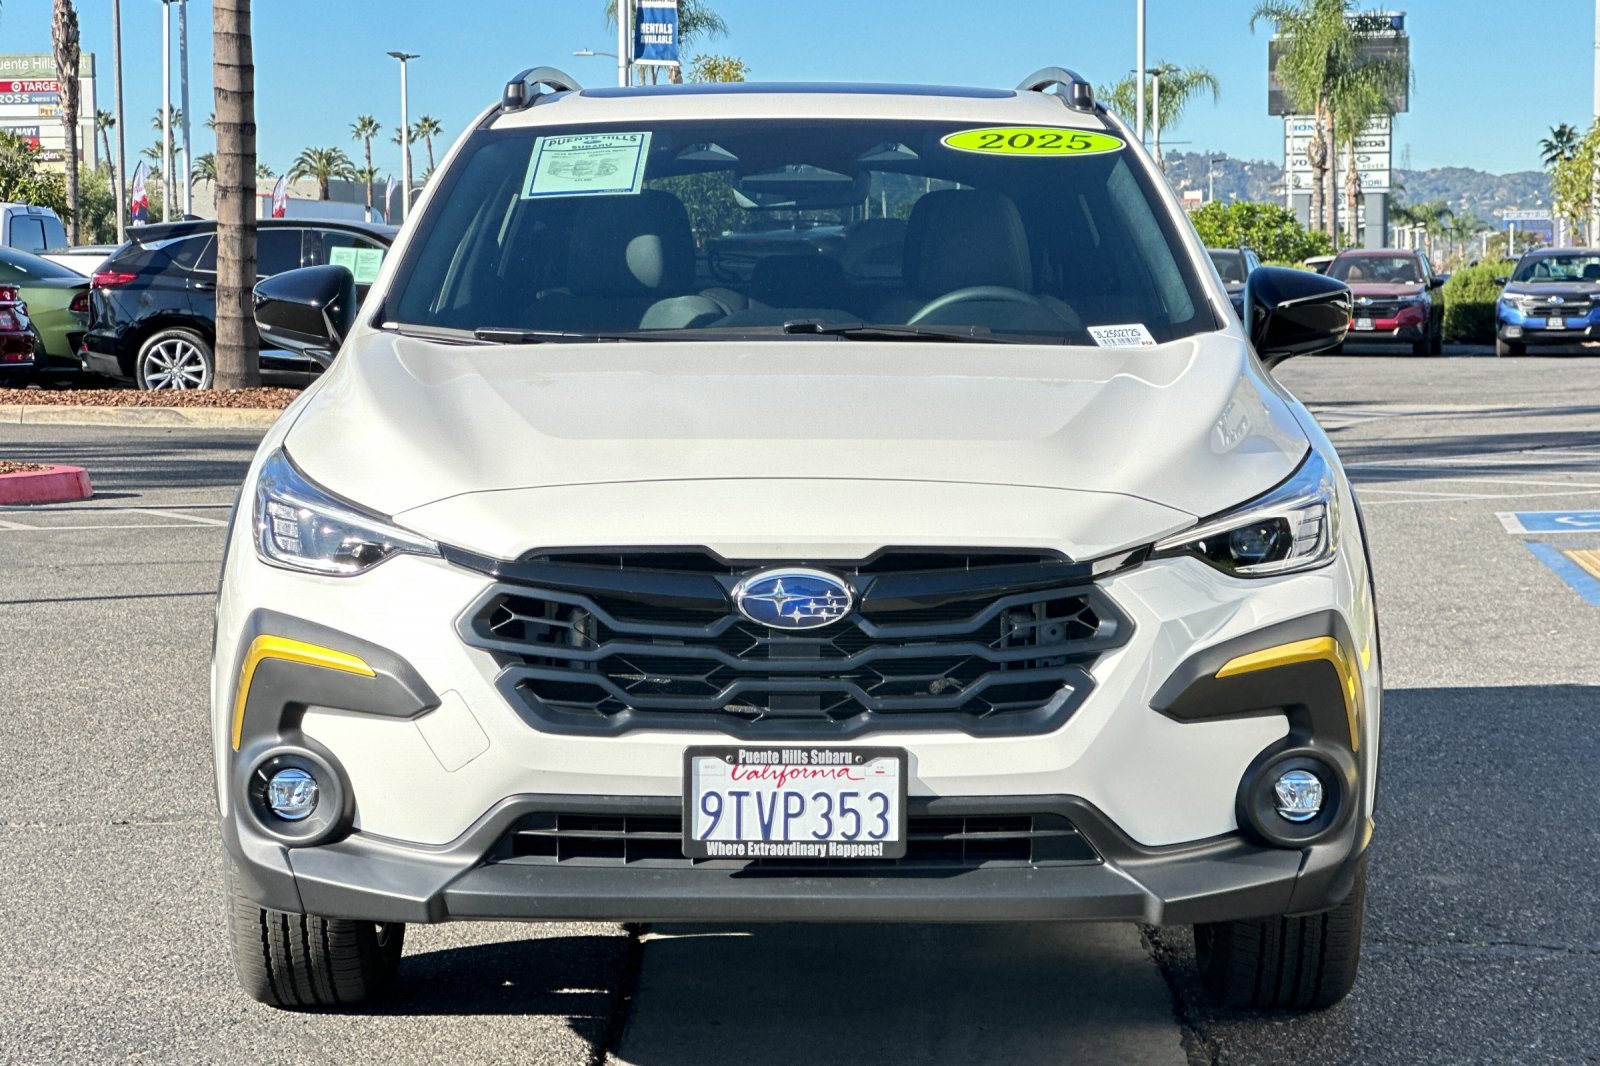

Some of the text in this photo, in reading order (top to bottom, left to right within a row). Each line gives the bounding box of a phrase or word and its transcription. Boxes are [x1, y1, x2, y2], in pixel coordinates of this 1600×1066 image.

[640, 23, 673, 34] RENTALS
[640, 35, 673, 44] AVAILABLE
[0, 57, 57, 70] uente Hills
[15, 127, 37, 136] NAVY
[977, 133, 1093, 150] 2025
[738, 749, 853, 765] Puente Hills Subaru
[730, 763, 866, 789] California
[699, 790, 890, 841] 9TVP353
[706, 841, 883, 857] Where Extraordinary Happens!
